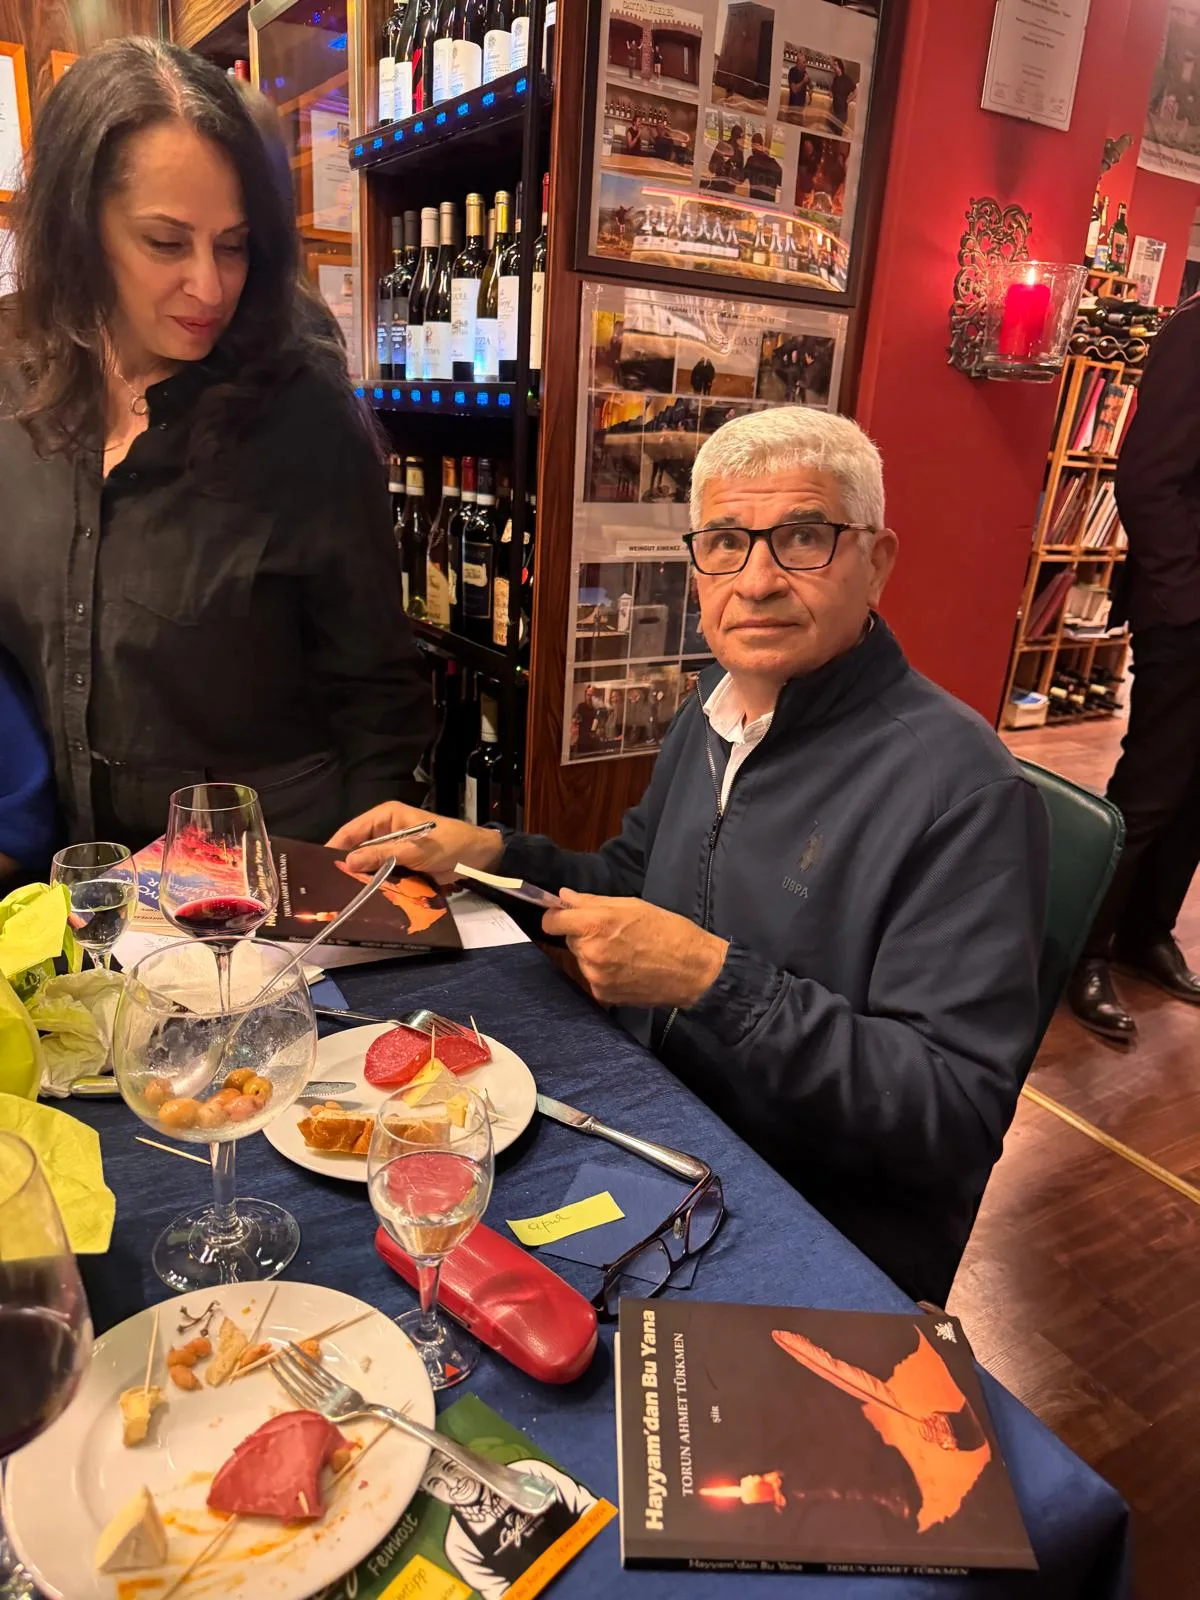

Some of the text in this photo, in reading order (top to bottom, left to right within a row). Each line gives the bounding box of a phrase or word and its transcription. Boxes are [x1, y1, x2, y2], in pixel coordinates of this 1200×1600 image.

[782, 876, 809, 899] USPA
[641, 1309, 657, 1357] Yana
[641, 1360, 659, 1388] Bu
[673, 1332, 694, 1498] TORUN AHMET TÜRKMEN
[761, 1560, 775, 1570] Bu
[778, 1561, 803, 1572] Yana
[826, 1563, 867, 1573] TORUN
[869, 1564, 908, 1574] AHMET
[913, 1565, 969, 1576] TÜRKMEN
